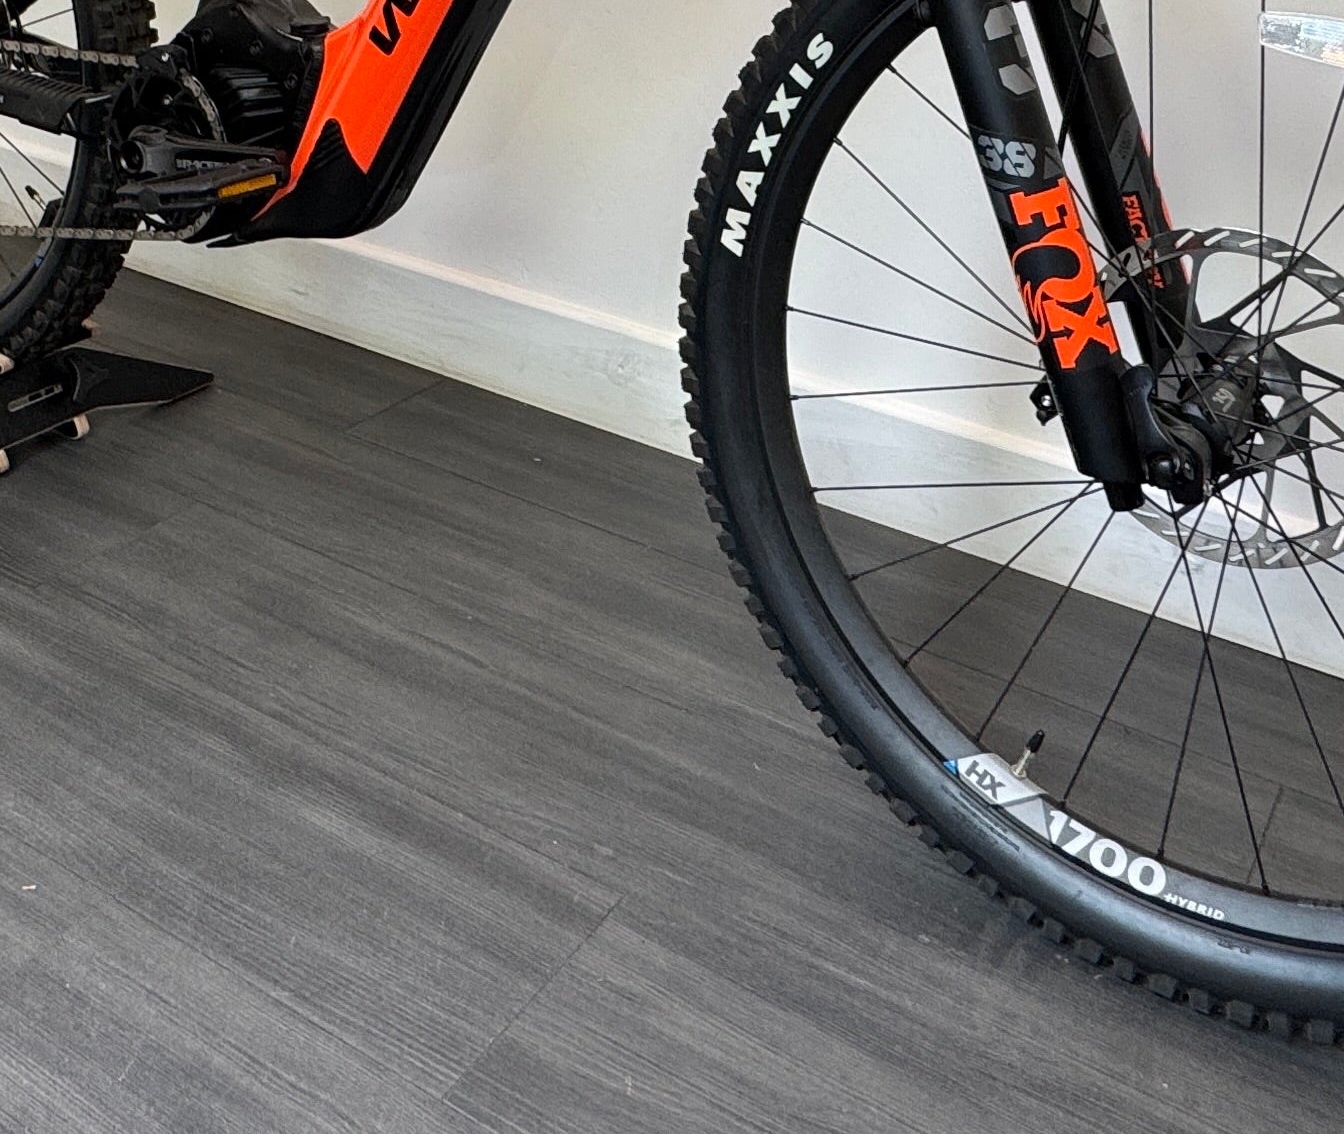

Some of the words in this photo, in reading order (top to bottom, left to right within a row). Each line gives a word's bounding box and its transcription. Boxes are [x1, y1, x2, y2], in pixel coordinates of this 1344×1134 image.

[719, 32, 836, 258] MAXXIS
[977, 134, 1037, 179] 38
[1009, 176, 1119, 369] FOX
[964, 760, 1006, 800] HX
[1048, 808, 1167, 896] 1700
[1163, 892, 1226, 922] HYBRID
